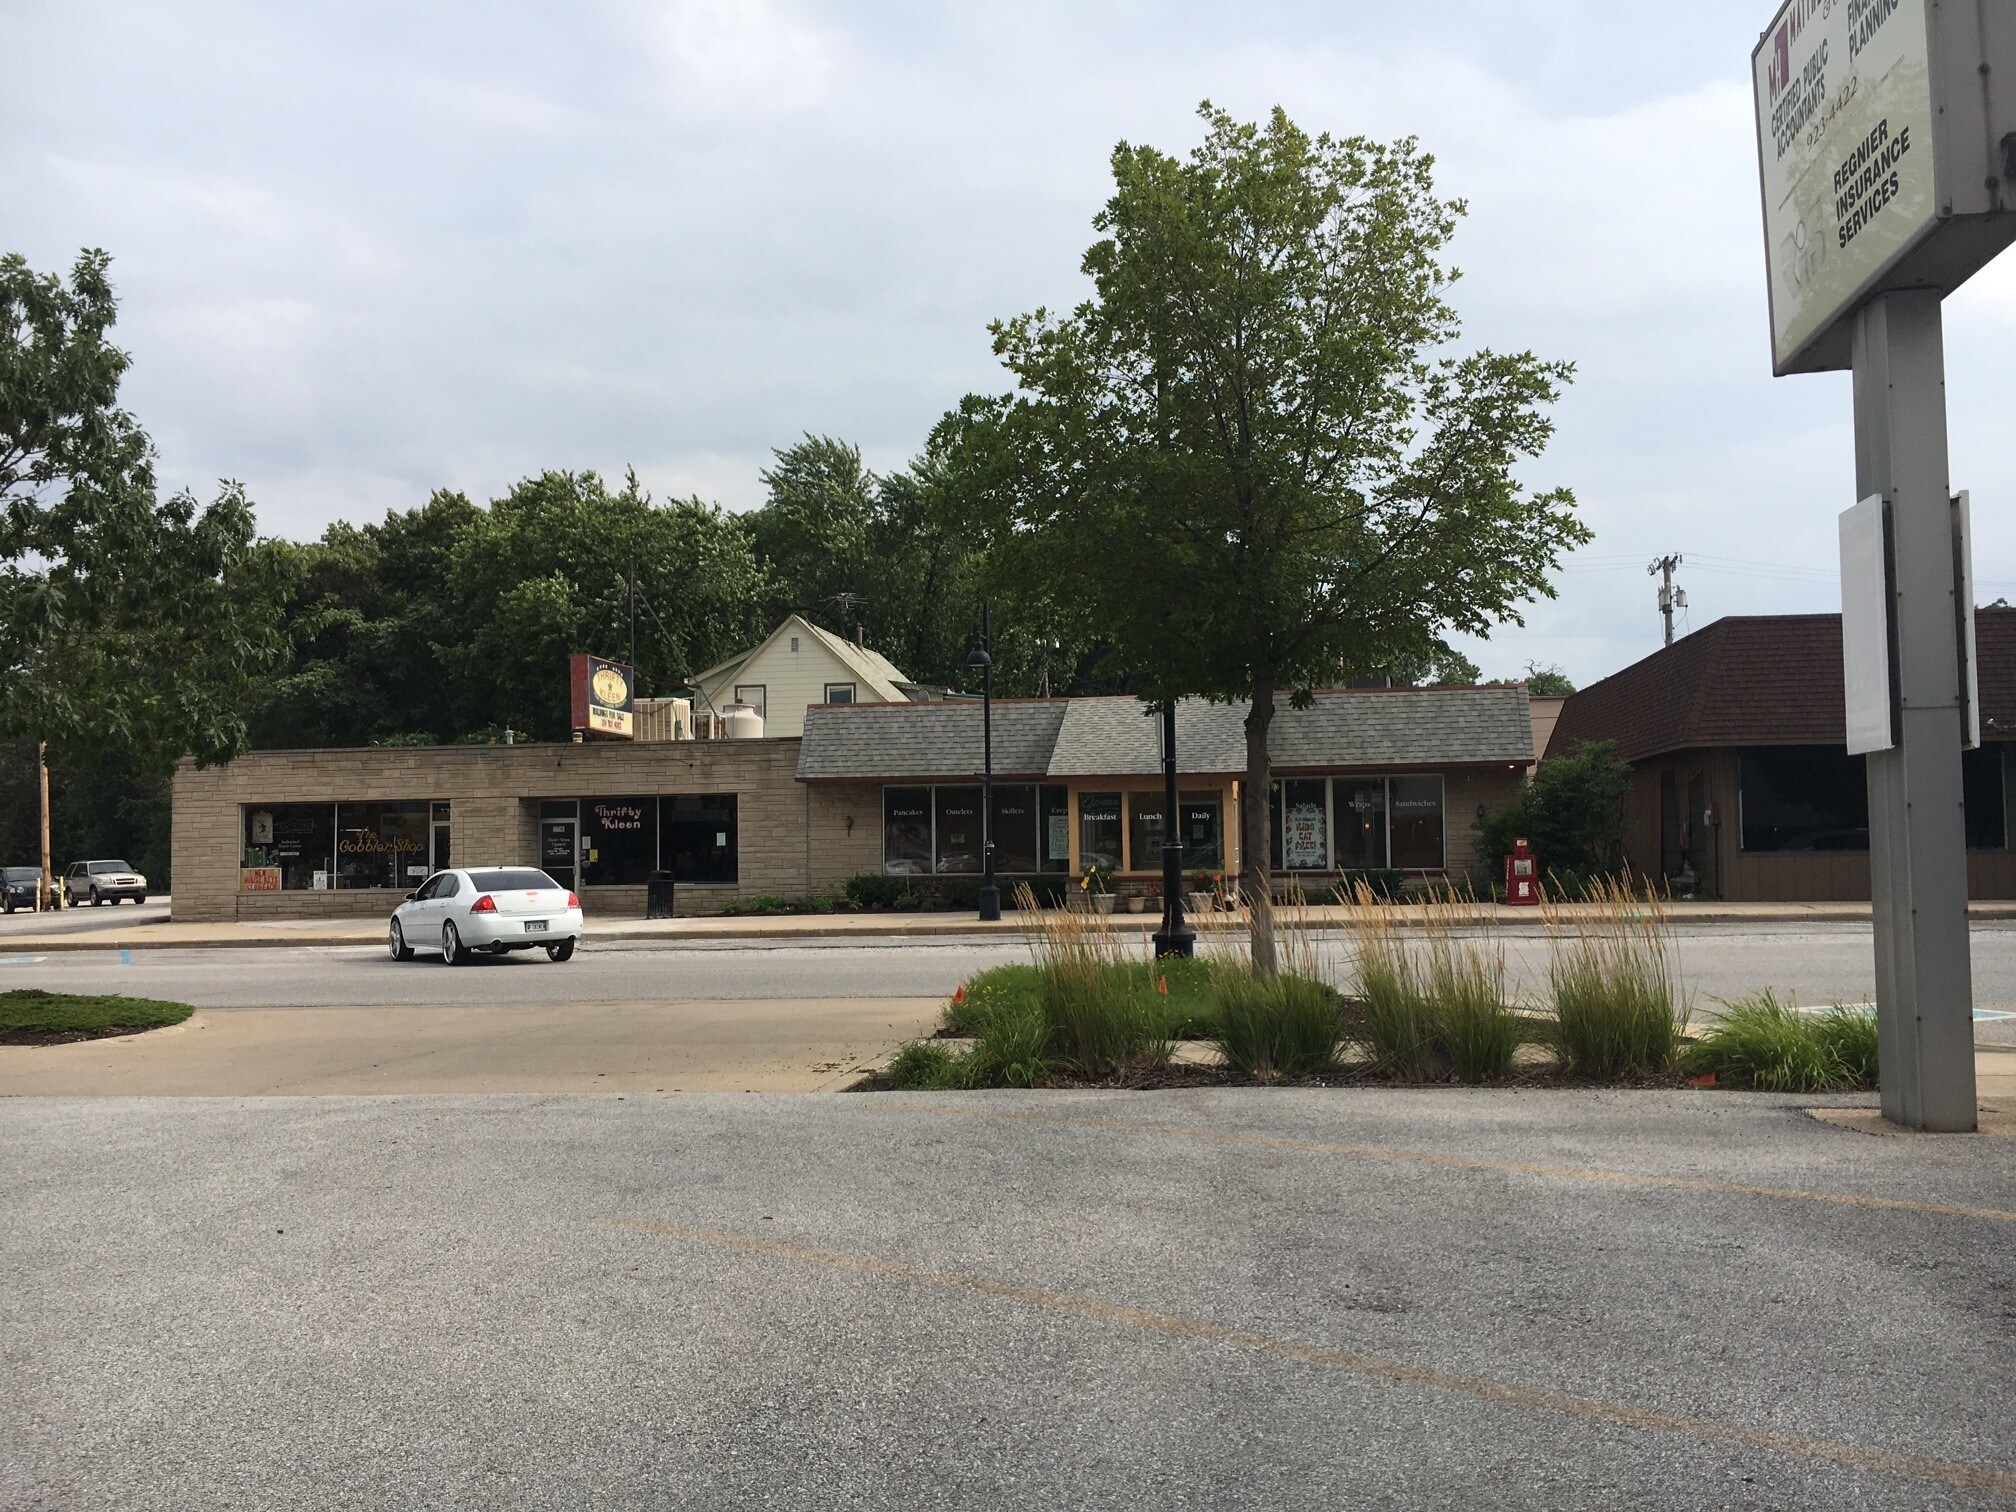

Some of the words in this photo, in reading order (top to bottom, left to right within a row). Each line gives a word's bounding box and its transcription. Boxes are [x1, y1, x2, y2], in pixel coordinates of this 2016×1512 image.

[1772, 77, 1801, 138] CERTIFIED
[1803, 38, 1829, 93] PUBLIC
[1777, 72, 1826, 162] ACCOUNTANTS
[1833, 119, 1889, 194] REGNIER
[1836, 126, 1911, 222] INSURANCE
[1838, 171, 1899, 249] SERVICES
[597, 670, 624, 688] THRIFTY
[599, 687, 621, 702] KLEEN
[1001, 807, 1025, 815] Skillets
[1348, 801, 1371, 809] Wraps
[594, 805, 642, 819] Thrifty
[945, 808, 973, 816] Omelets
[1083, 812, 1117, 821] Breakfast
[1139, 812, 1163, 821] Lunch
[1191, 812, 1211, 821] Daily
[601, 817, 641, 829] Kleen
[356, 826, 378, 839] The
[1298, 832, 1313, 840] EAT
[393, 838, 424, 856] Shop
